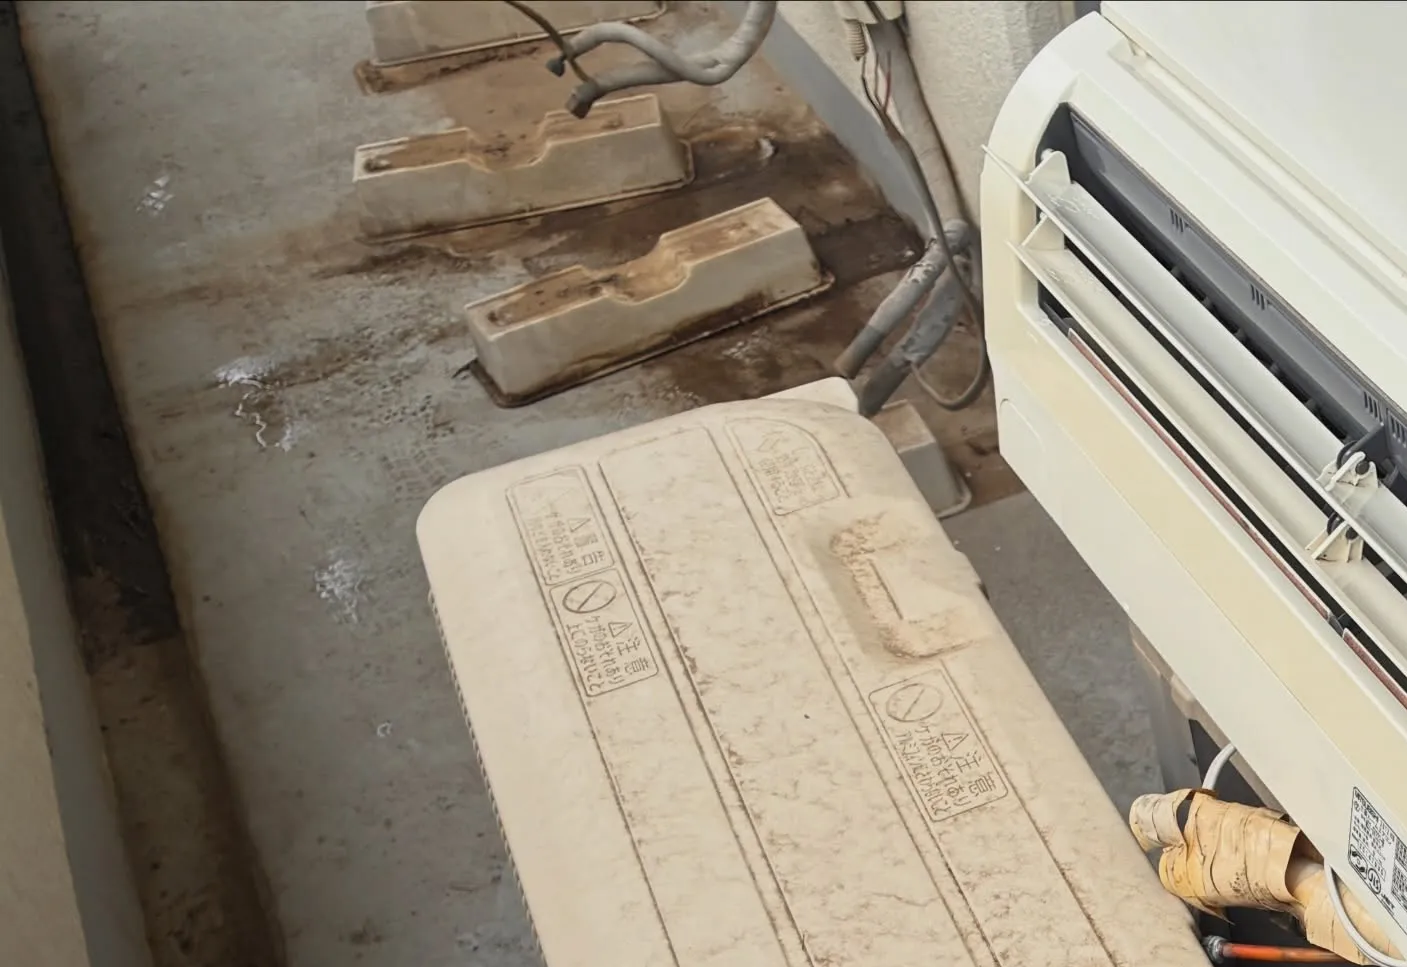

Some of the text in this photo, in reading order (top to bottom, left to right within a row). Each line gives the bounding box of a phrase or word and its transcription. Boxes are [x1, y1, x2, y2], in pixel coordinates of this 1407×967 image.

[565, 619, 606, 692] 上にのらないこと
[584, 613, 626, 686] ケガのおそれあり
[614, 635, 652, 676] 注意
[913, 722, 973, 809] ケガのおそれあり
[950, 746, 998, 799] 注意
